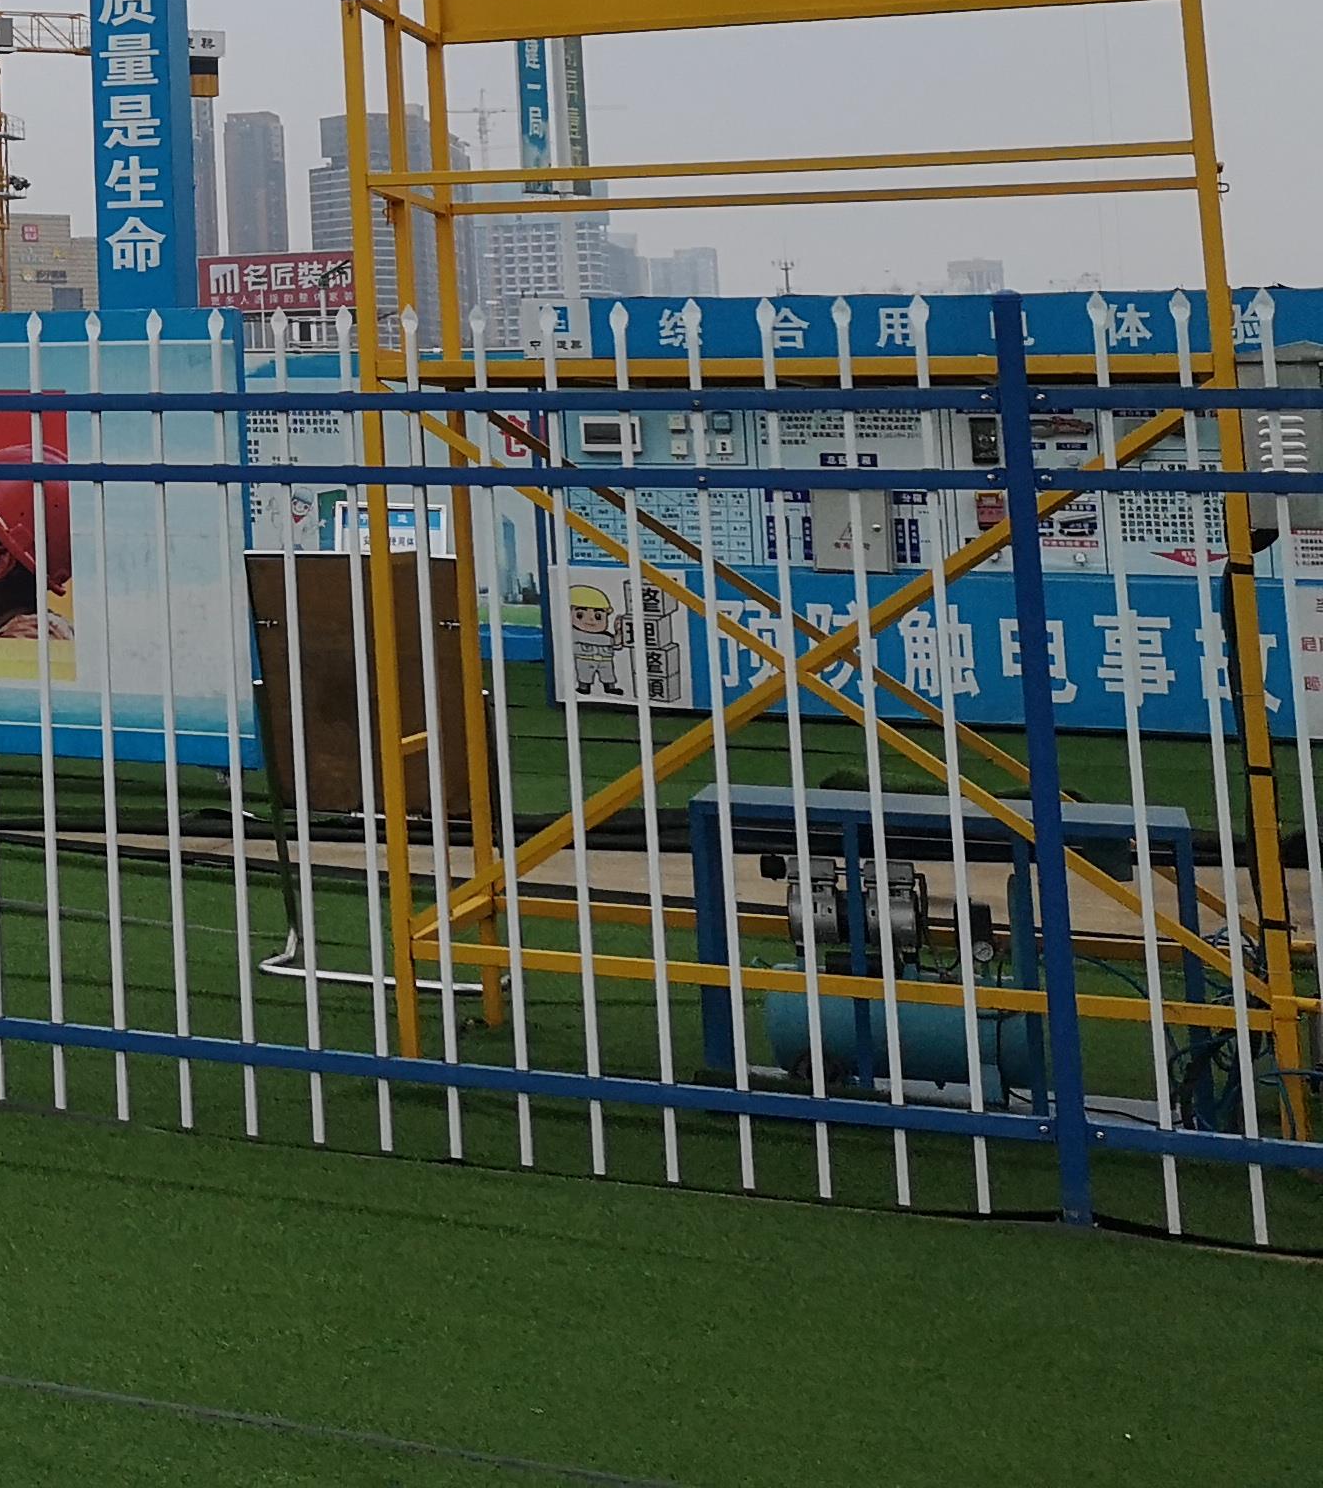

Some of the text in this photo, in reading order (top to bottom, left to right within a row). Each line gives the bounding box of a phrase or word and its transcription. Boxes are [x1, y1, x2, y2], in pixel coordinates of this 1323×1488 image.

[243, 260, 353, 292] 名匠装饰
[658, 303, 1263, 350] 综合用体验
